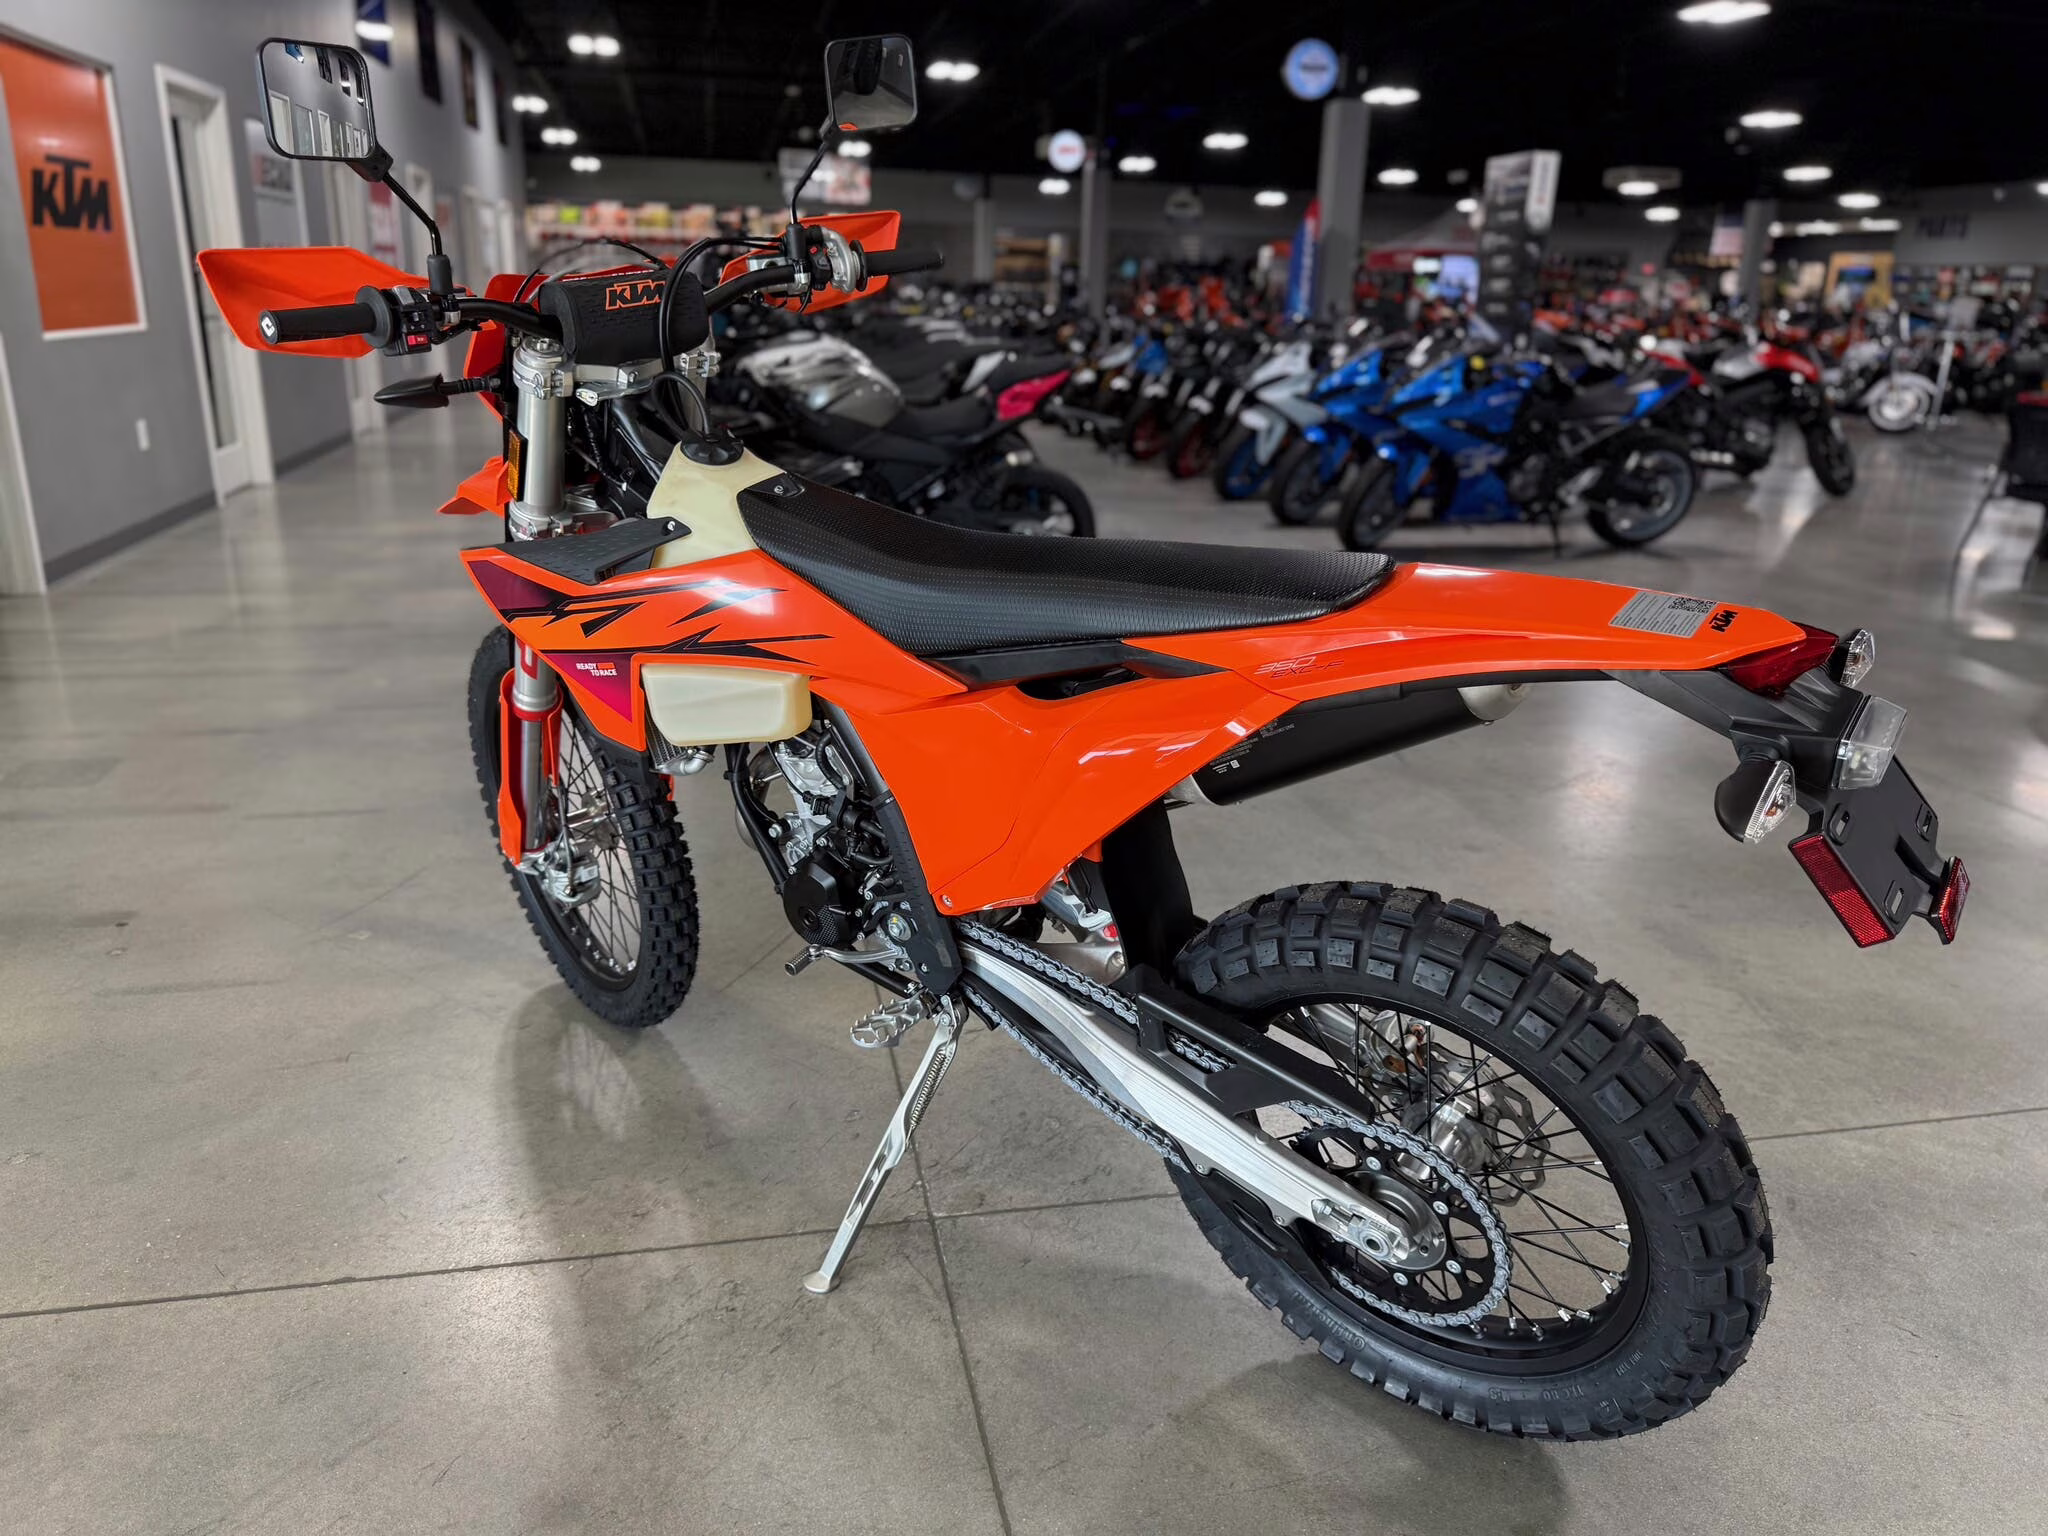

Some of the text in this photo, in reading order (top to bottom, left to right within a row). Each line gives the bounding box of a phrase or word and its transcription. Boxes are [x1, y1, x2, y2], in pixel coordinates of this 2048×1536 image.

[32, 154, 112, 232] KTM
[606, 279, 665, 311] KTM
[1709, 609, 1738, 633] KTM
[575, 662, 597, 670] READY
[600, 668, 618, 676] RACE
[1253, 655, 1316, 675] 350
